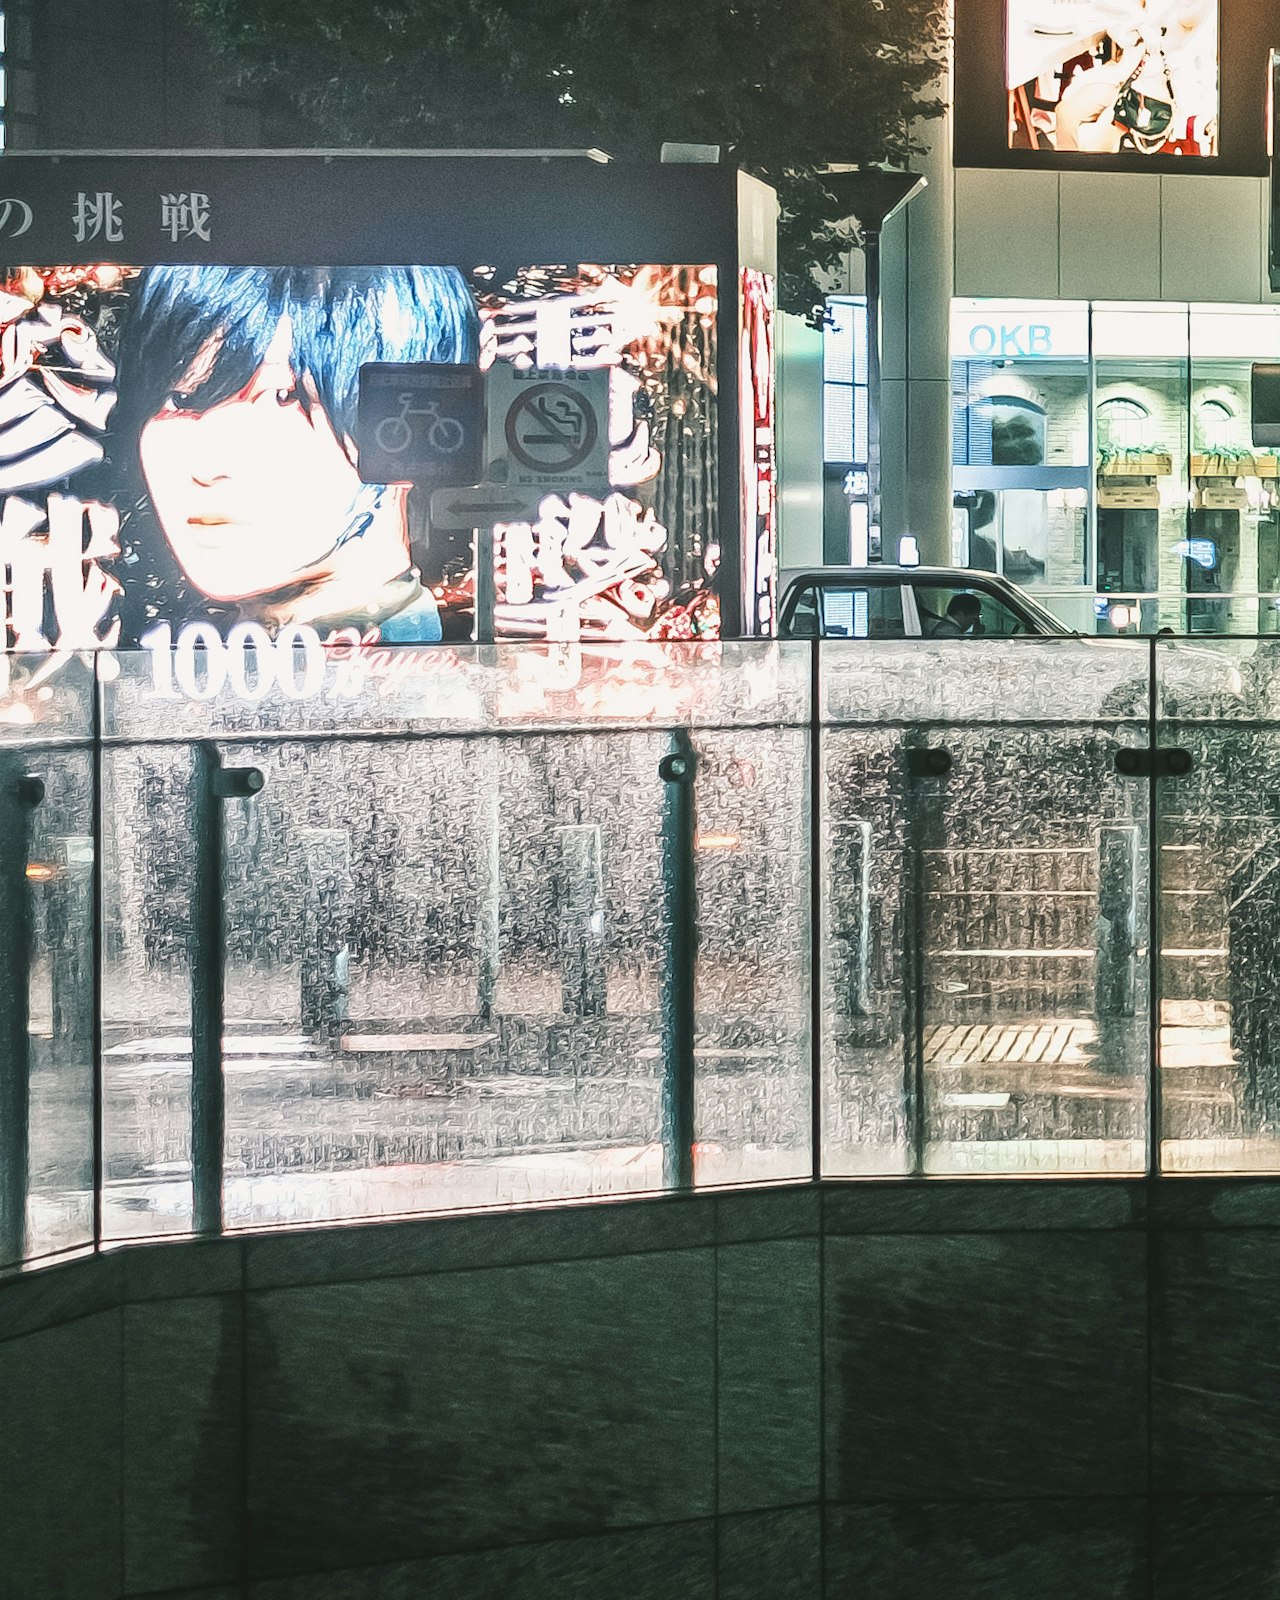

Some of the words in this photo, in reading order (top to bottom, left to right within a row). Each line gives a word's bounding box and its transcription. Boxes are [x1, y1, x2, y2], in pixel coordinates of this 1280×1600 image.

[0, 191, 212, 243] の挑戦
[969, 324, 1053, 356] OKB
